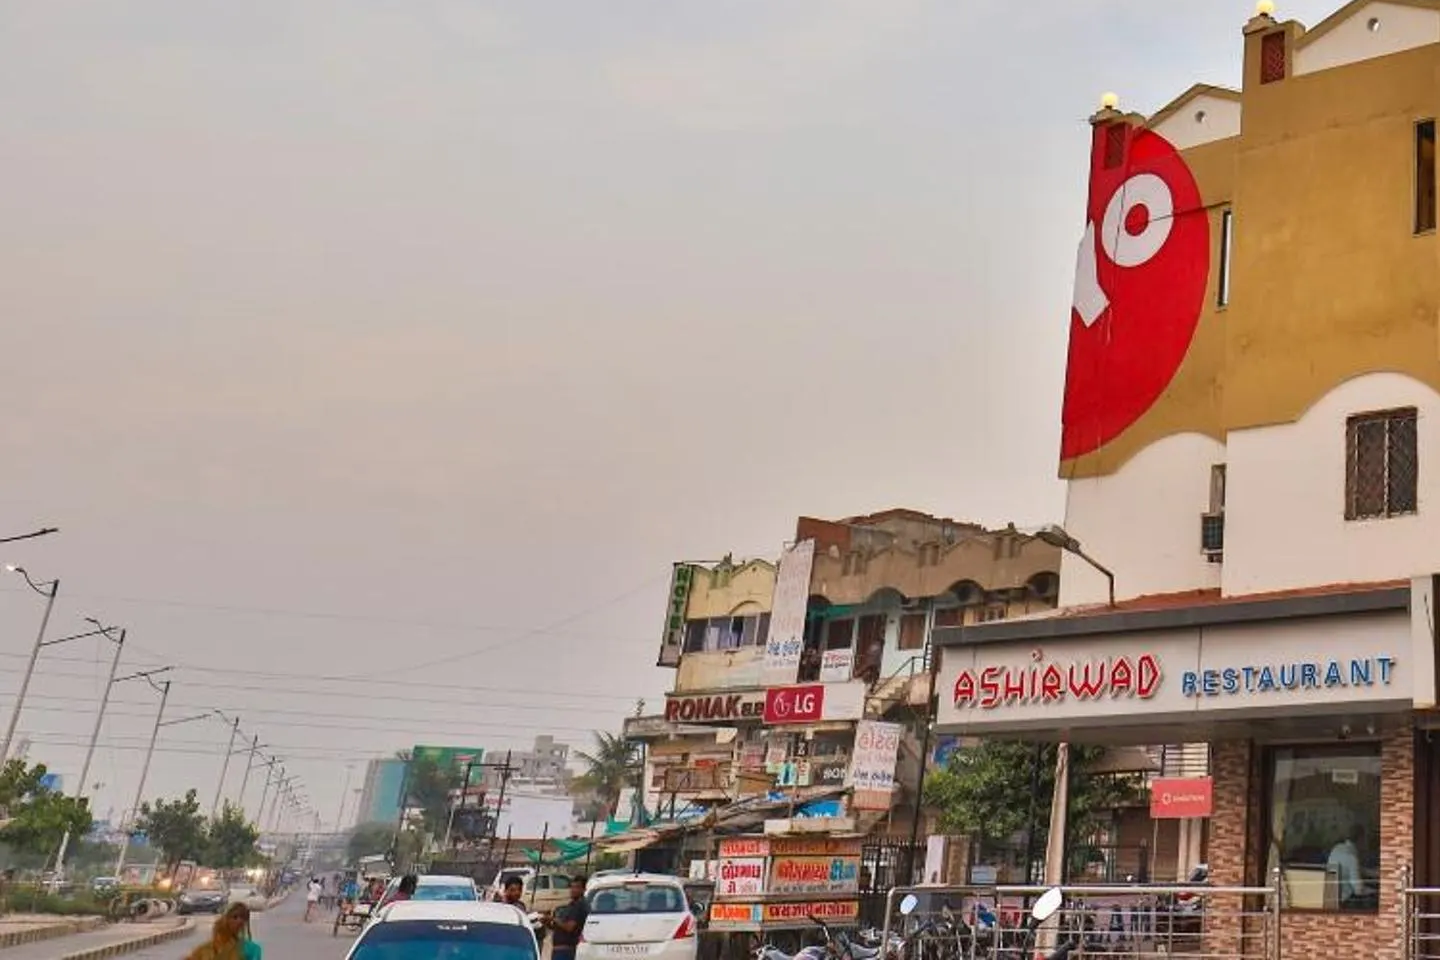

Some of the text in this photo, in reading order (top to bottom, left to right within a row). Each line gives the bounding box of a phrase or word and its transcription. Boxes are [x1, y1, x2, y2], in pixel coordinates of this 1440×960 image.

[953, 652, 1397, 708] ASHIRWAD RESTAURANT
[794, 693, 815, 714] LG
